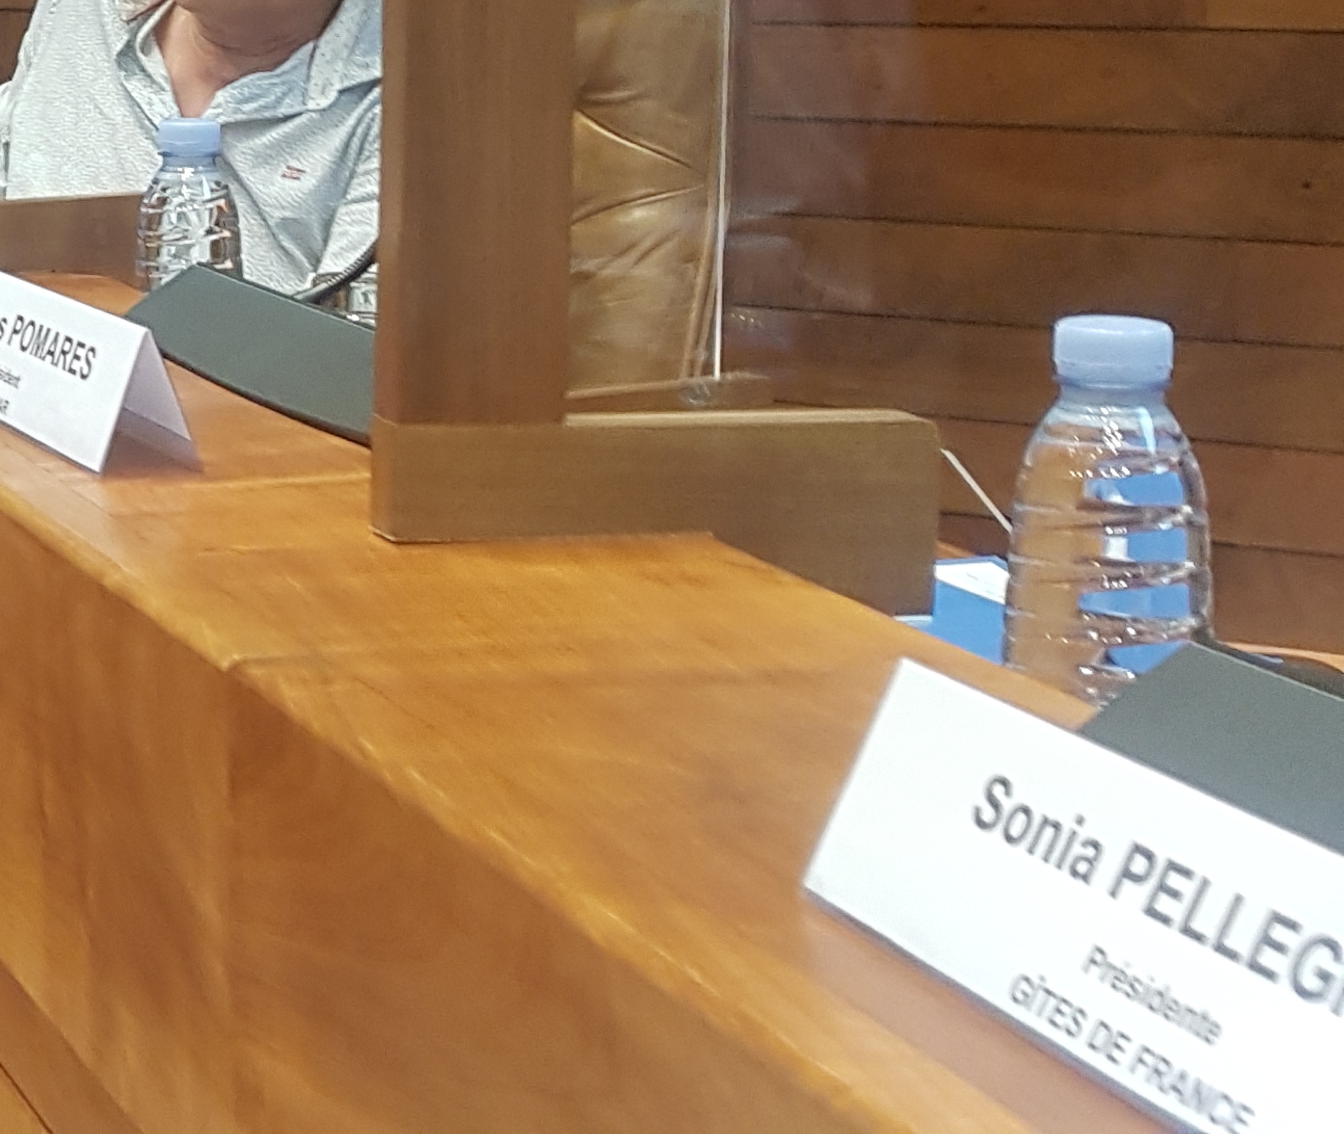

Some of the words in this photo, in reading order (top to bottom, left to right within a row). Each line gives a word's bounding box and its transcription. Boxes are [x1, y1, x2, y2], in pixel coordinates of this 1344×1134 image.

[7, 314, 97, 381] POMARES
[972, 773, 1104, 886] Sonia
[1106, 839, 1344, 1018] PELLEG
[1081, 943, 1224, 1046] Présidente
[1086, 1018, 1133, 1067] DE
[1128, 1043, 1256, 1134] FRANCE
